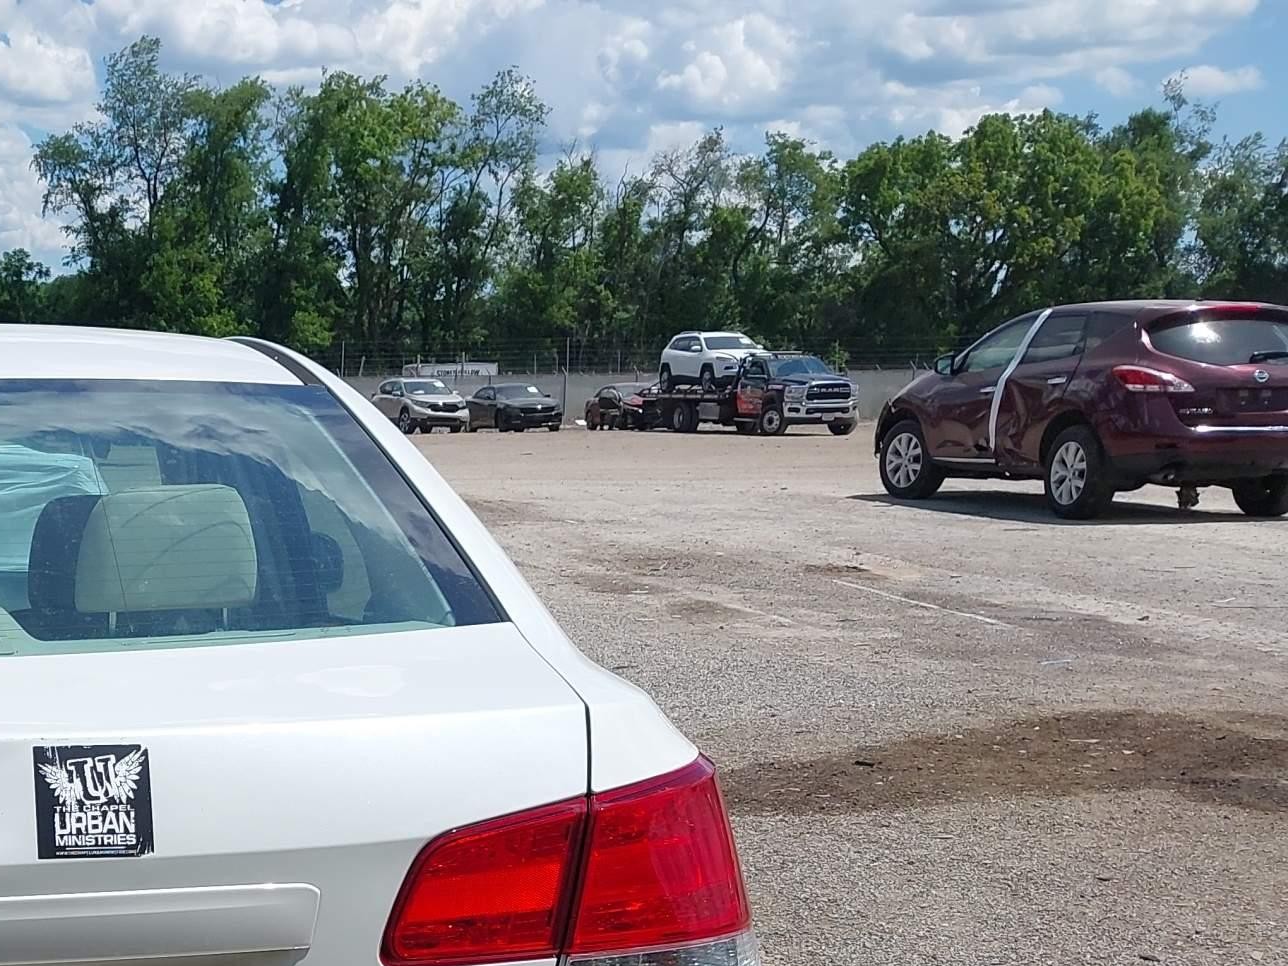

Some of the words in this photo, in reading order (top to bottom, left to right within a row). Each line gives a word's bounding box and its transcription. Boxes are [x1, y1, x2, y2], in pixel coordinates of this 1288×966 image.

[53, 804, 80, 813] THE
[83, 804, 135, 812] CHAPEL
[54, 811, 135, 835] URBAN
[55, 834, 137, 847] MINISTRIES
